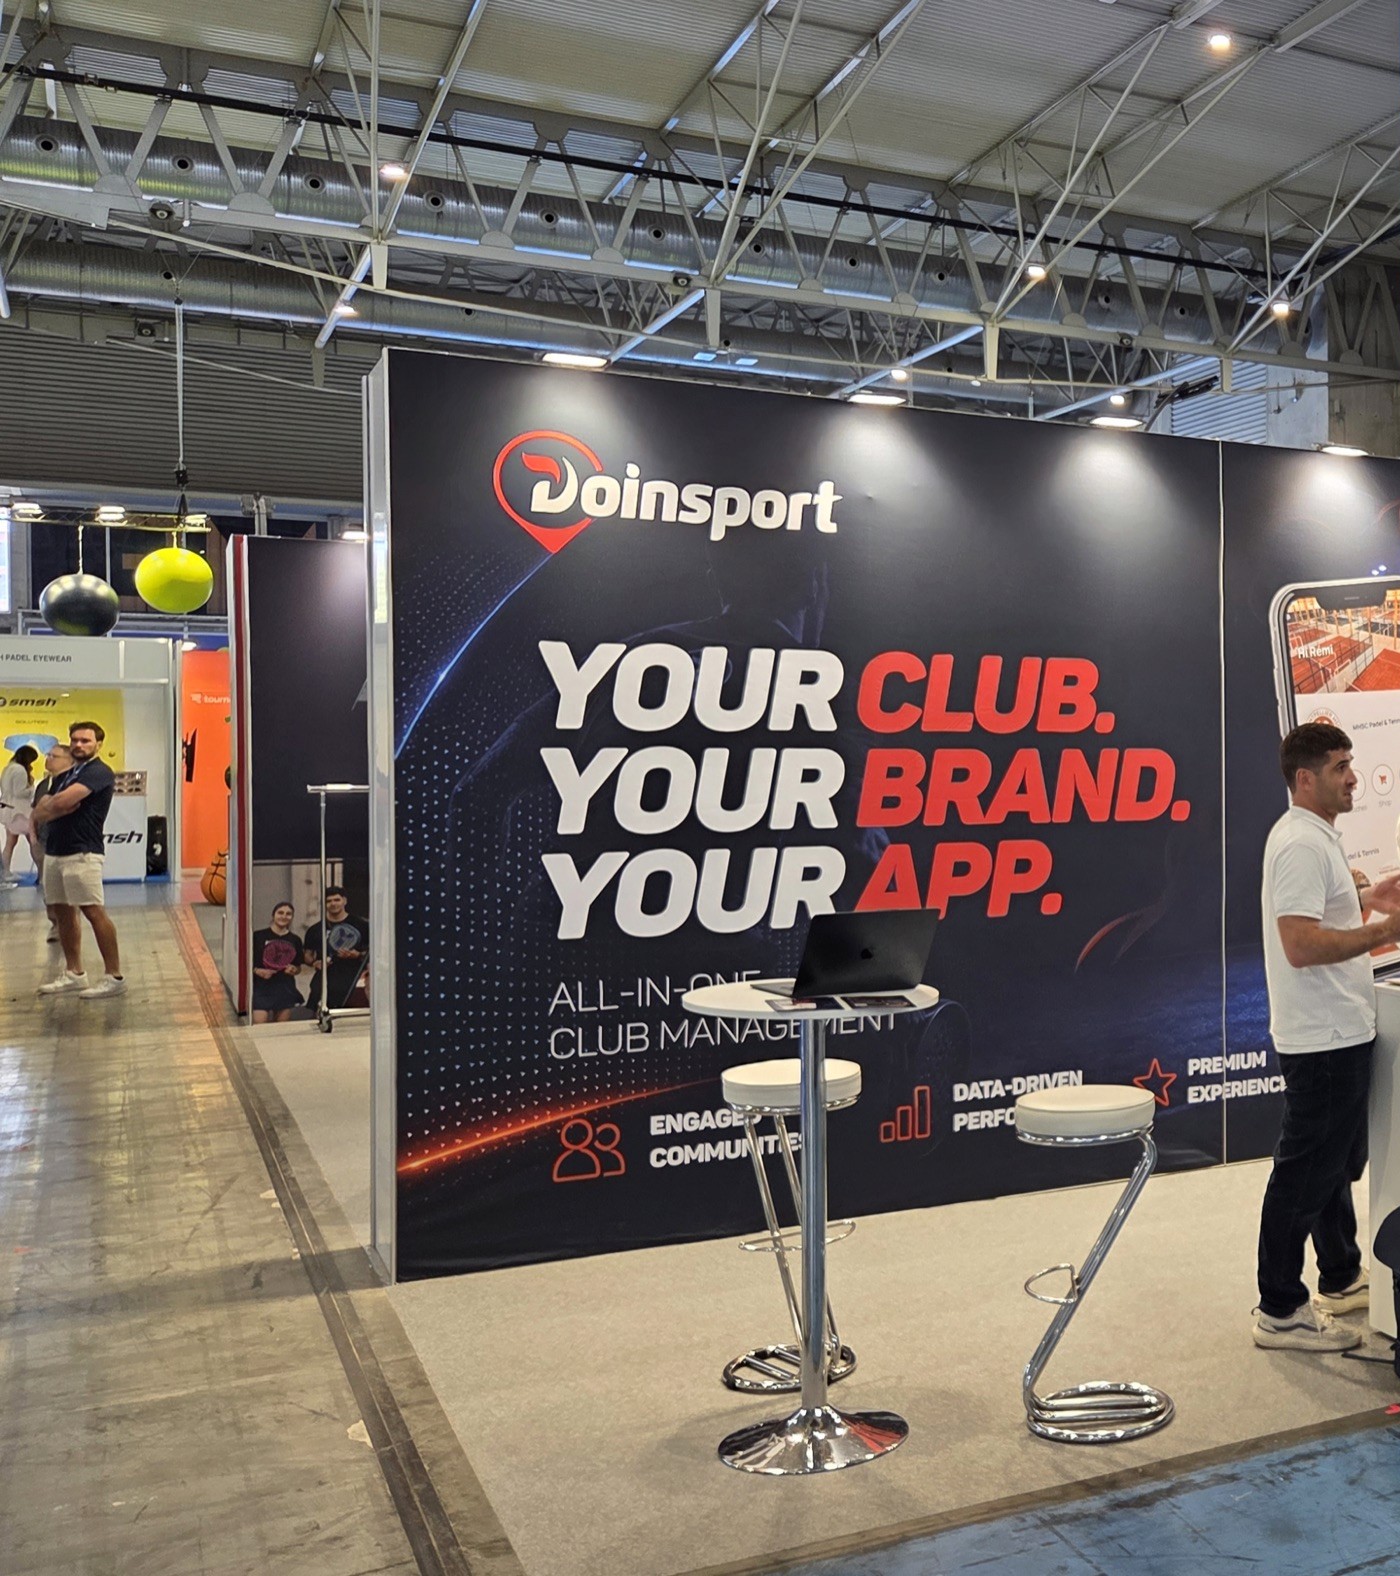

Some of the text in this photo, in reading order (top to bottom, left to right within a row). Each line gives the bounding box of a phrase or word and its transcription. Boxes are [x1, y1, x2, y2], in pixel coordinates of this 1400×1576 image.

[522, 452, 843, 541] Doinsport
[5, 654, 31, 662] PADEL
[33, 654, 72, 662] EYEWEAR
[9, 697, 57, 707] smsh
[538, 640, 1115, 734] YOUR CLUB.
[539, 745, 1191, 835] YOUR BRAND.
[541, 839, 1063, 940] YOUR APP.
[549, 1022, 650, 1060] CLUB
[1188, 1050, 1267, 1076] PREMIUM
[953, 1070, 1083, 1102] DATA-DRIVEN
